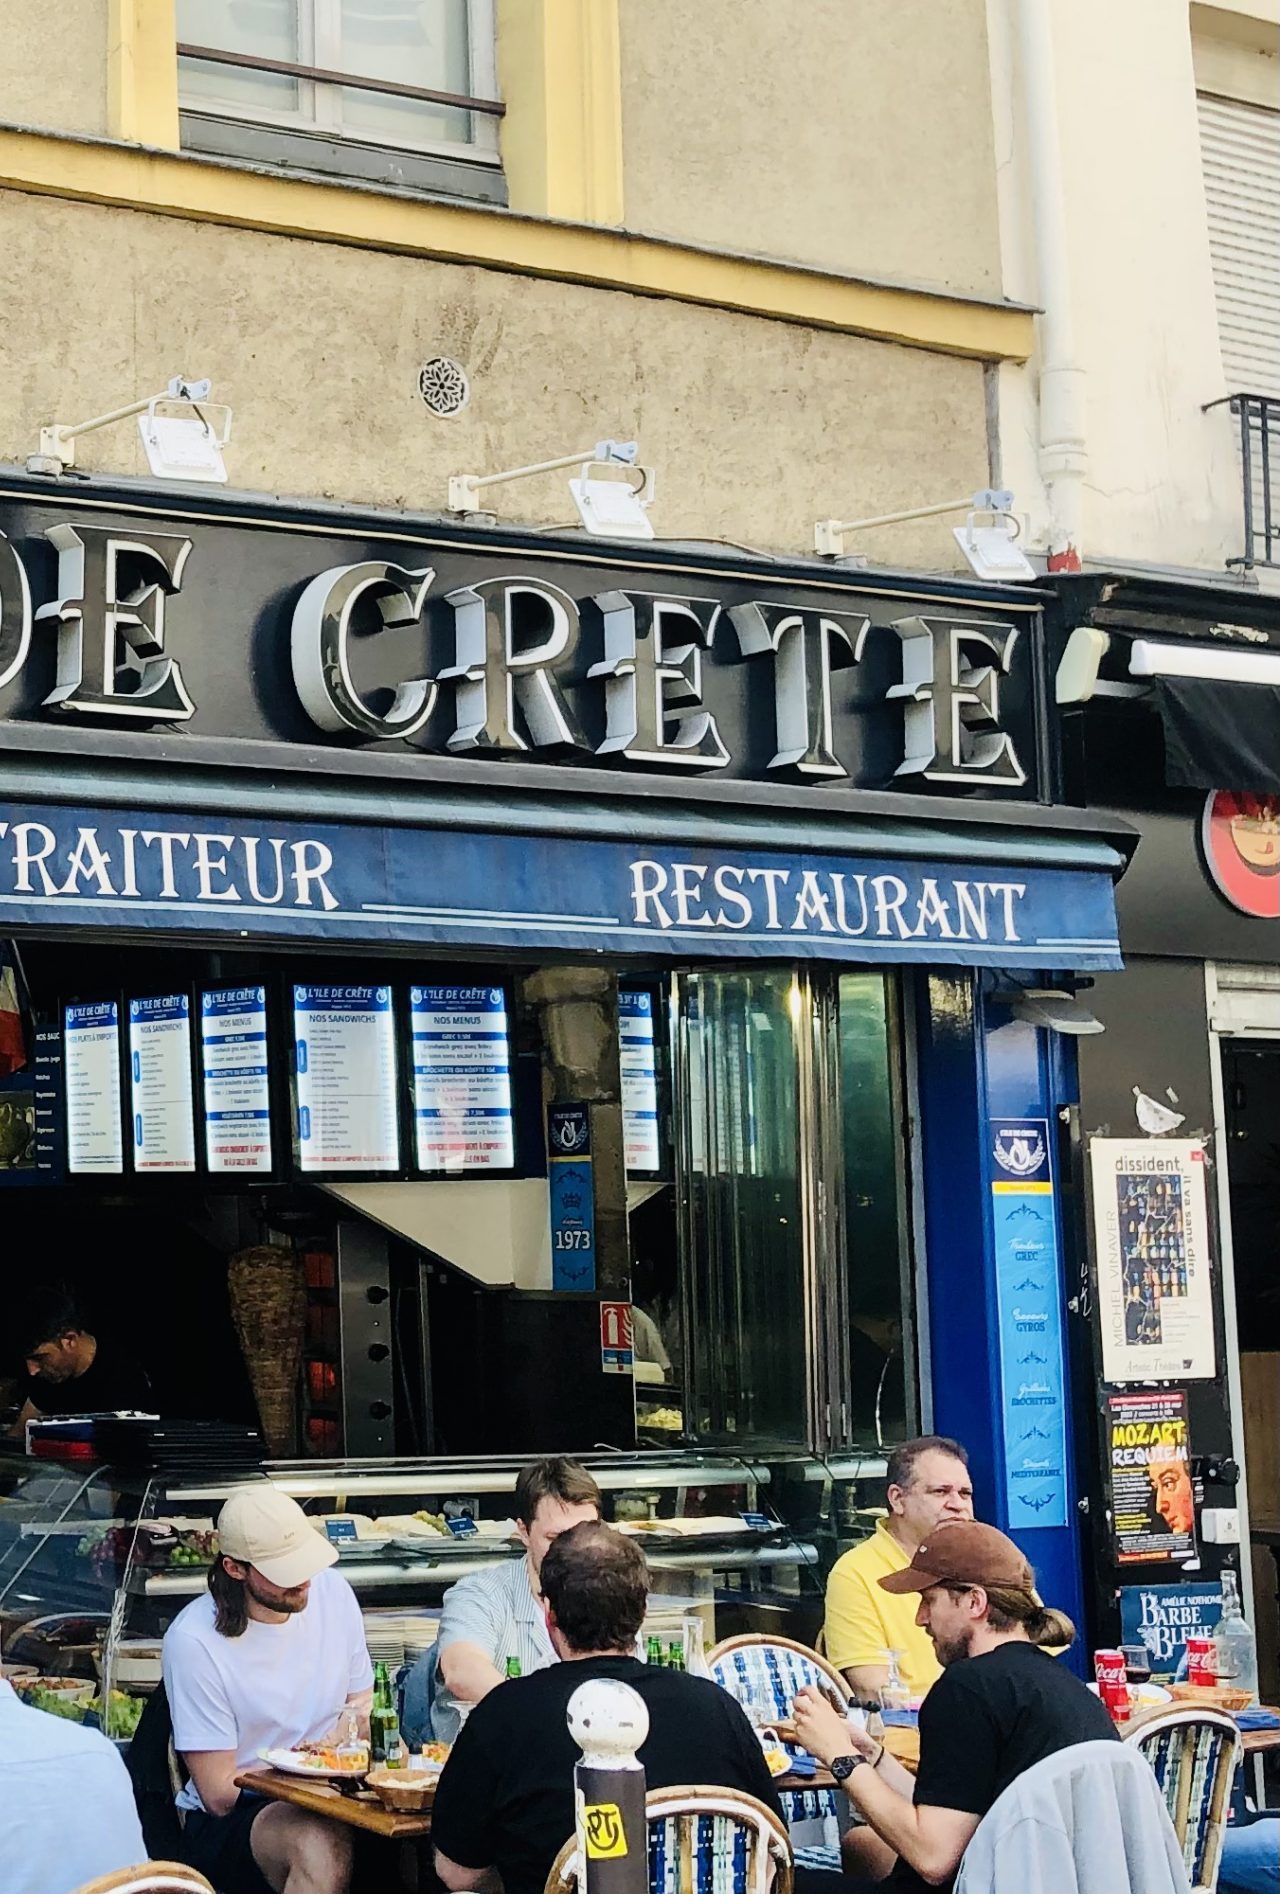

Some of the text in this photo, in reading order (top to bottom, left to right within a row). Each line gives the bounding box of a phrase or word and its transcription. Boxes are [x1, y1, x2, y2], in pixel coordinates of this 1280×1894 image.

[290, 560, 1026, 786] CRETE
[629, 860, 1027, 941] RESTAURANT
[331, 988, 342, 998] DE
[446, 989, 457, 999] DE
[309, 1014, 327, 1022] NOS
[434, 1016, 481, 1025] NOS MENUS
[1184, 1189, 1193, 1206] va
[1185, 1212, 1195, 1244] sans
[556, 1230, 591, 1250] 1973
[1015, 1251, 1038, 1261] GREC
[1187, 1249, 1196, 1278] dire
[1106, 1210, 1124, 1348] MICHEL VINAVER
[1016, 1322, 1046, 1332] GYROS
[1112, 1420, 1186, 1448] MOZART
[1112, 1446, 1188, 1466] REQUIEM
[1140, 1591, 1202, 1627] BARBE
